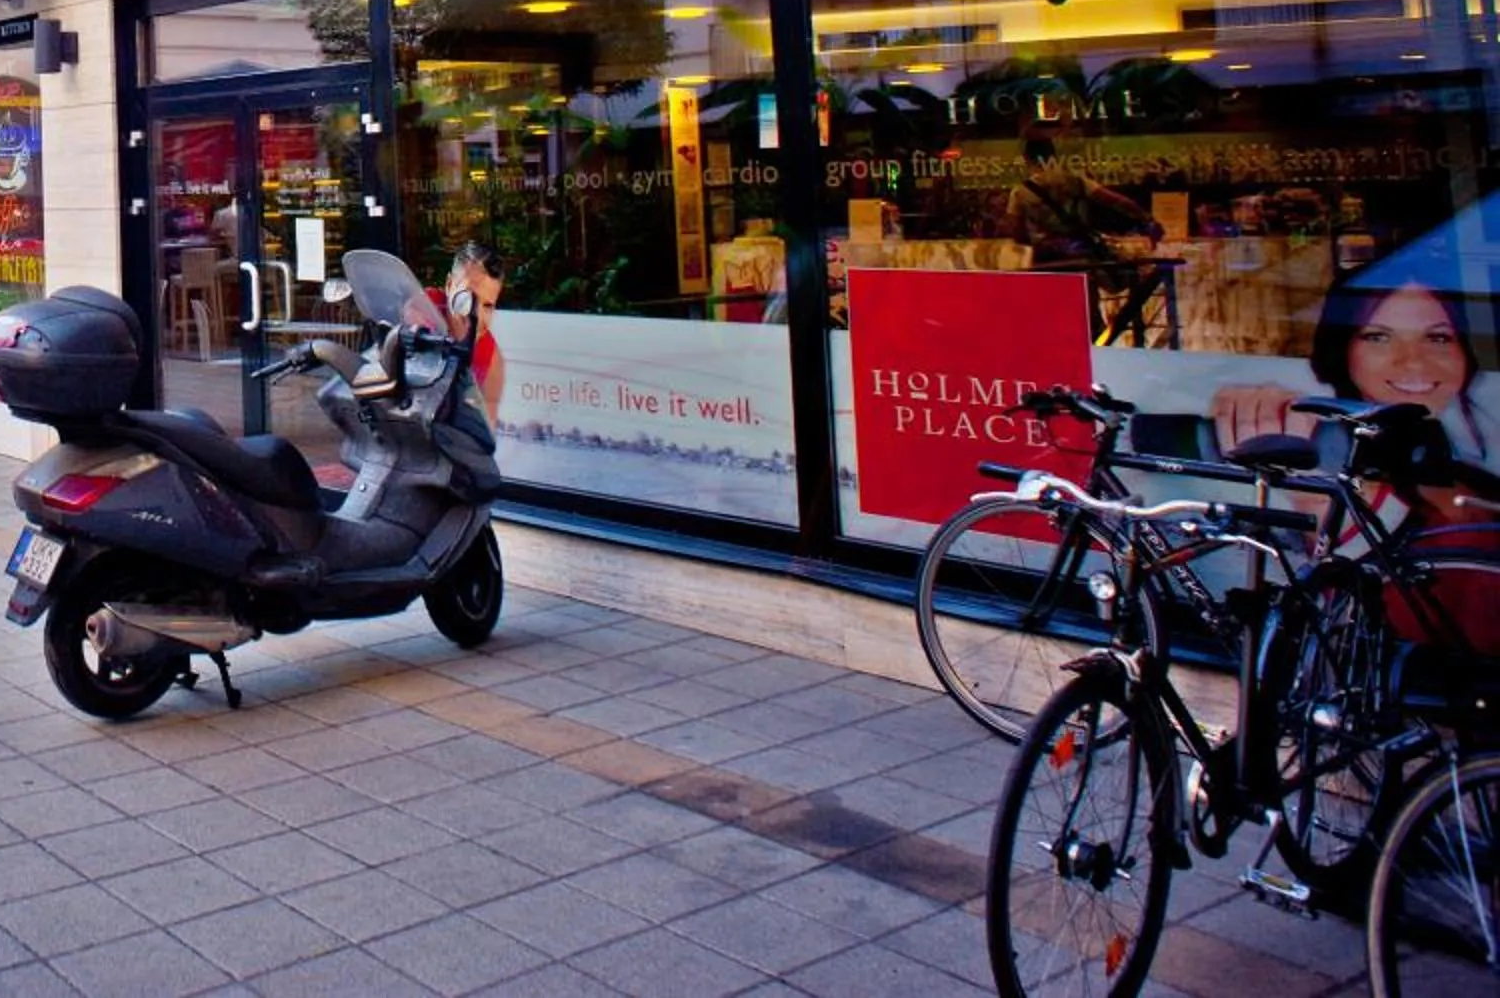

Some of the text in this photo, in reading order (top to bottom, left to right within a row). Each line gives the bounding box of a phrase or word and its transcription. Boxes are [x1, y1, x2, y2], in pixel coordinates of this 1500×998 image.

[563, 167, 609, 196] pool
[632, 168, 675, 195] gym
[703, 159, 780, 186] cardio
[826, 156, 902, 188] group
[911, 149, 1000, 180] fitness
[521, 378, 761, 426] one life. live it well.
[871, 368, 1073, 410] HOLME
[894, 404, 1049, 448] PLACE
